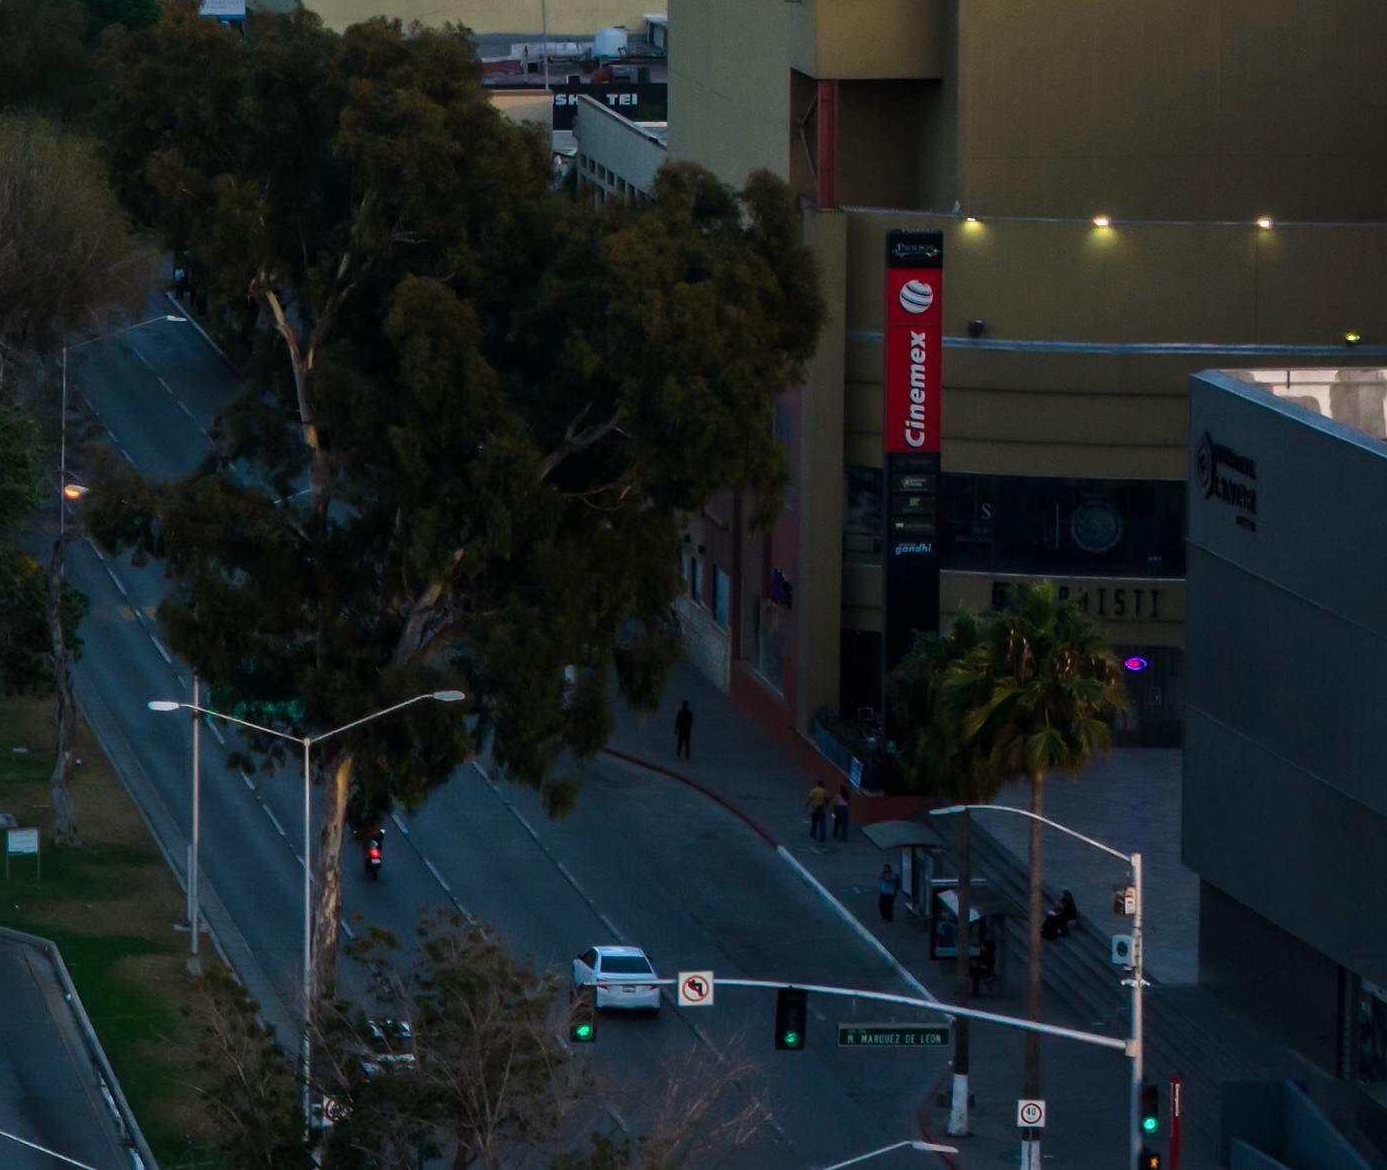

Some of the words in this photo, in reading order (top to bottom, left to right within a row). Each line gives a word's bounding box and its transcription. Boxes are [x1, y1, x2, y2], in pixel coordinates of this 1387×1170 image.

[905, 331, 926, 448] Cinemex
[895, 543, 932, 556] gandhi
[861, 1034, 900, 1044] MARQUEZ
[905, 1034, 916, 1044] DE
[920, 1034, 942, 1044] LEON
[1026, 1106, 1036, 1115] 40
